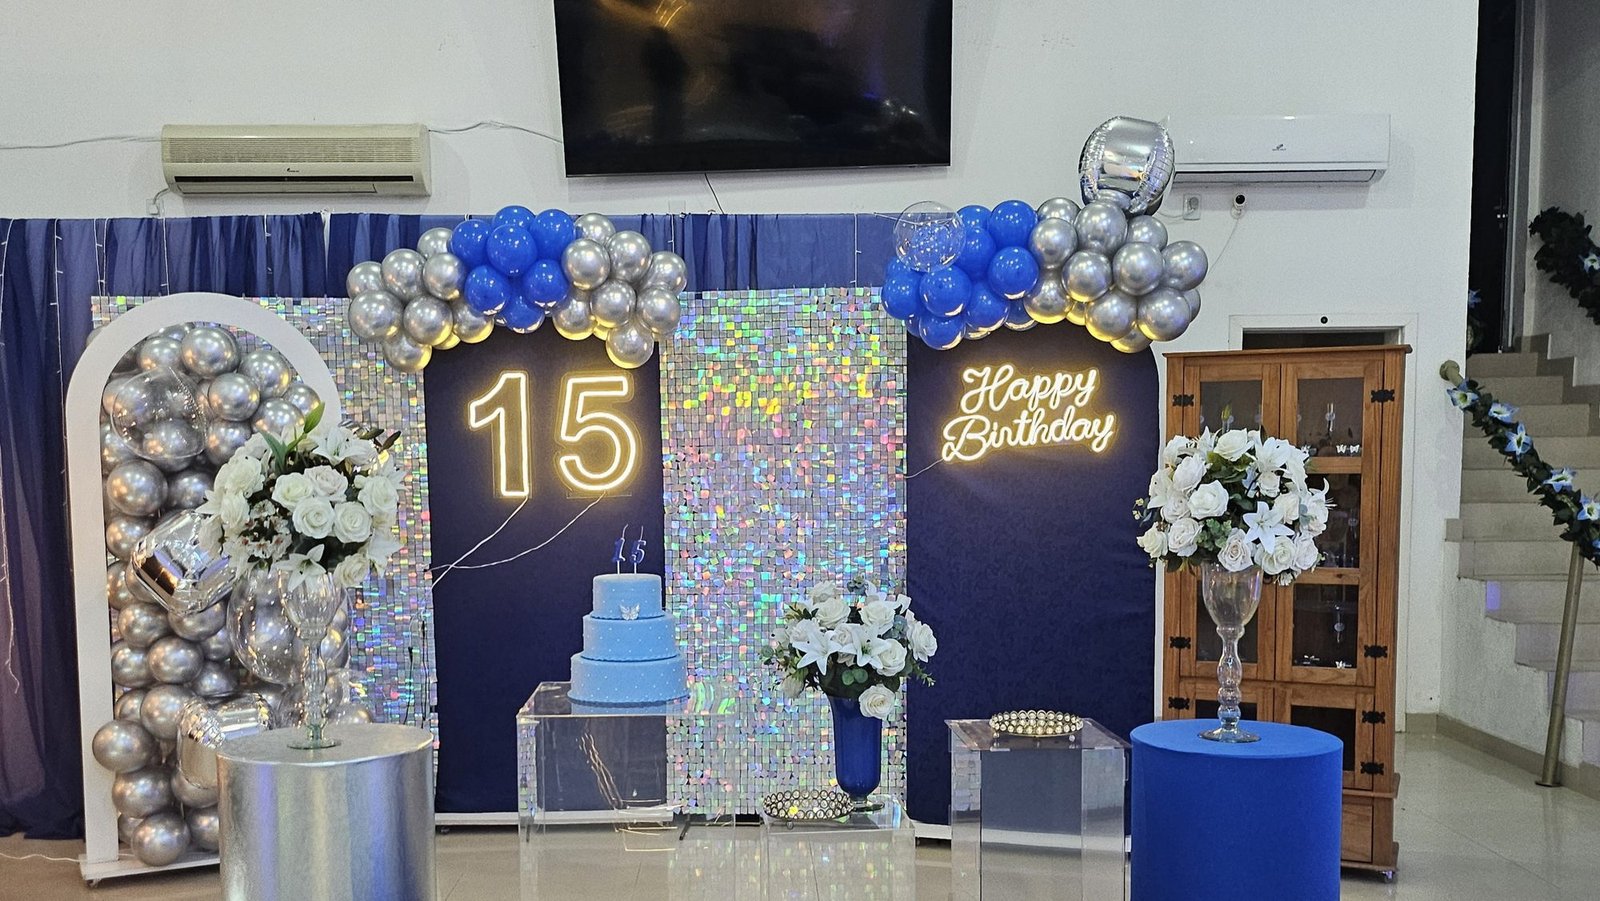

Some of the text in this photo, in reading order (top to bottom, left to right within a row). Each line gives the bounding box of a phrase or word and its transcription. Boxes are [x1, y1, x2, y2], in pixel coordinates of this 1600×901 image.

[960, 364, 1098, 414] Happy
[468, 371, 638, 497] 15
[942, 405, 1115, 462] Birthday
[612, 537, 647, 564] 15
